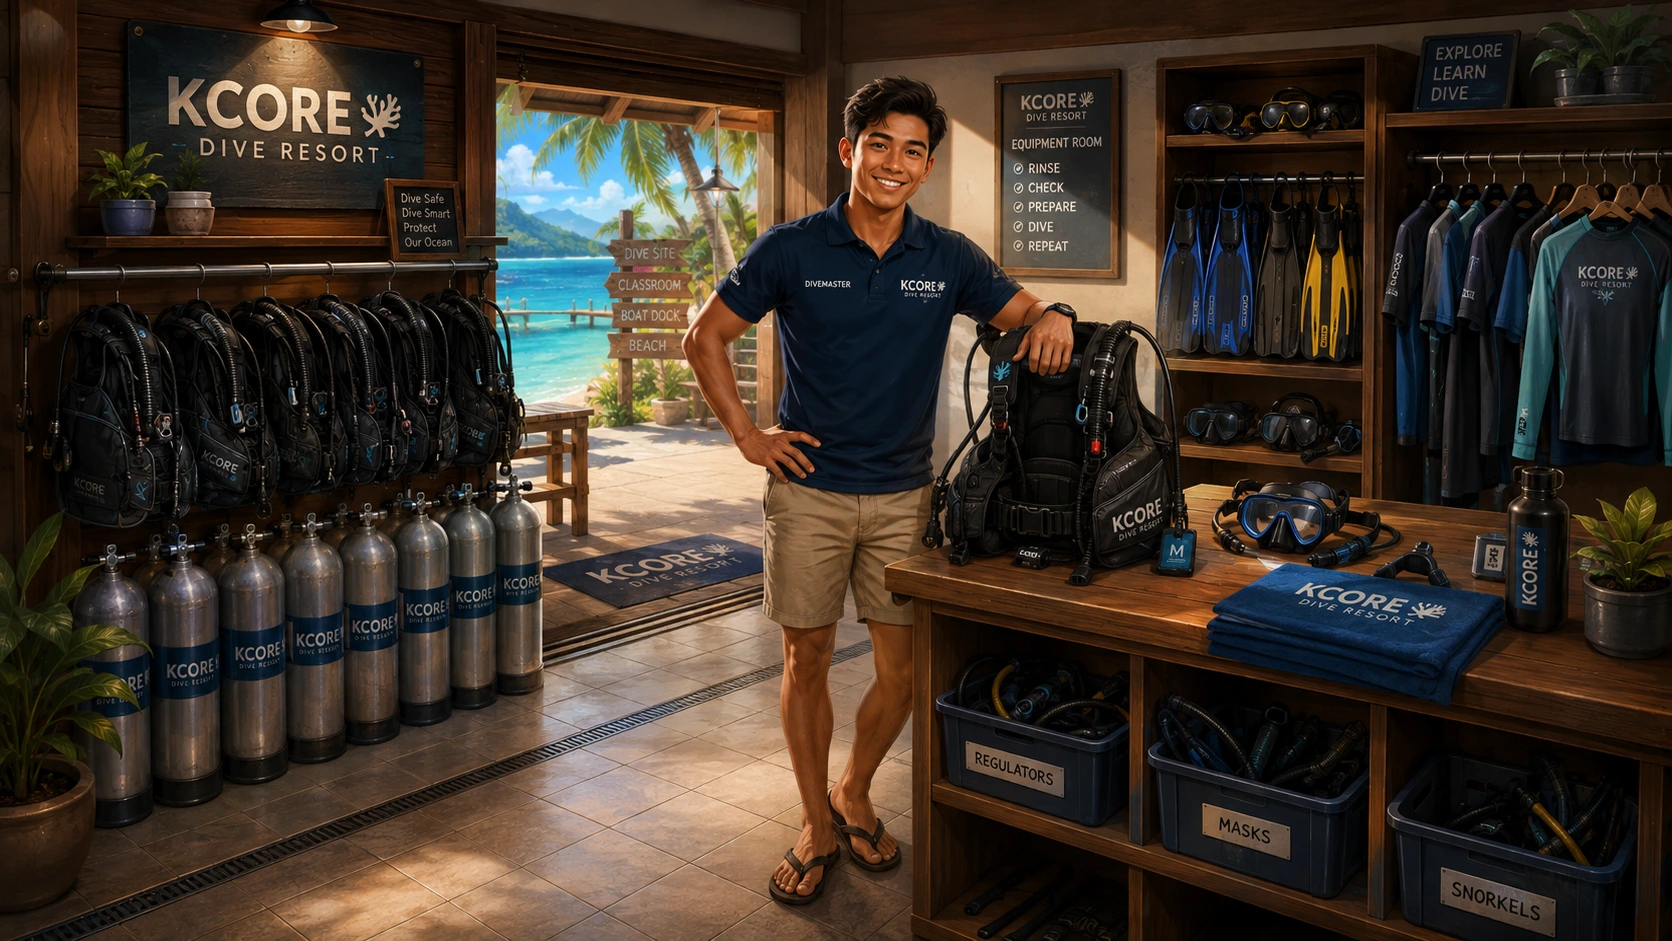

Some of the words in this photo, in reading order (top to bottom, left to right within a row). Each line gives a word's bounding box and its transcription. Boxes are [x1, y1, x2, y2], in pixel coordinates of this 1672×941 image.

[1436, 43, 1503, 60] EXPLORE
[1434, 64, 1486, 80] LEARN
[1021, 93, 1077, 110] KCORE
[1431, 86, 1469, 101] DIVE
[168, 76, 352, 136] KCORE
[1026, 112, 1047, 122] DIVE
[1050, 111, 1087, 121] RESORT
[200, 137, 264, 159] DIVE
[281, 142, 379, 163] RESORT
[1011, 137, 1069, 151] EQUIPMENT
[1072, 136, 1102, 148] ROOM
[1028, 162, 1060, 174] RINSE
[1028, 182, 1064, 193] CHECK
[401, 193, 421, 204] Dive
[424, 193, 445, 204] Safe
[1028, 201, 1077, 212] PREPARE
[402, 207, 422, 218] Dive
[424, 208, 451, 218] Smart
[403, 222, 437, 232] Protect
[1028, 221, 1054, 232] DIVE
[404, 237, 422, 248] Our
[424, 236, 453, 248] Ocean
[1028, 240, 1069, 251] REPEAT
[624, 247, 649, 260] DIVE
[652, 246, 676, 260] SITE
[1578, 266, 1624, 279] KCORE
[618, 279, 682, 292] CLASSROOM
[805, 280, 851, 289] DIVEMASTER
[900, 280, 937, 292] KCORE
[621, 309, 648, 321] BOAT
[651, 309, 681, 322] DOCK
[629, 339, 667, 351] BEACH
[201, 450, 239, 474] KCORE
[74, 477, 105, 495] KCORE
[1112, 498, 1162, 533] KCORE
[1169, 544, 1184, 558] M
[585, 549, 714, 584] KCORE
[503, 574, 540, 590] KCORE
[629, 573, 673, 588] DIVE
[1521, 548, 1539, 606] KCORE
[456, 587, 493, 603] KCORE
[1295, 582, 1409, 613] KCORE
[406, 600, 446, 616] KCORE
[1298, 598, 1339, 612] DIVE
[1342, 607, 1415, 626] RESORT
[352, 615, 394, 634] KCORE
[296, 628, 340, 648] KCORE
[235, 641, 281, 662] KCORE
[167, 658, 214, 679] KCORE
[975, 751, 1054, 786] REGULATORS
[1219, 816, 1271, 844] MASKS
[1451, 882, 1541, 921] SNORKELS
